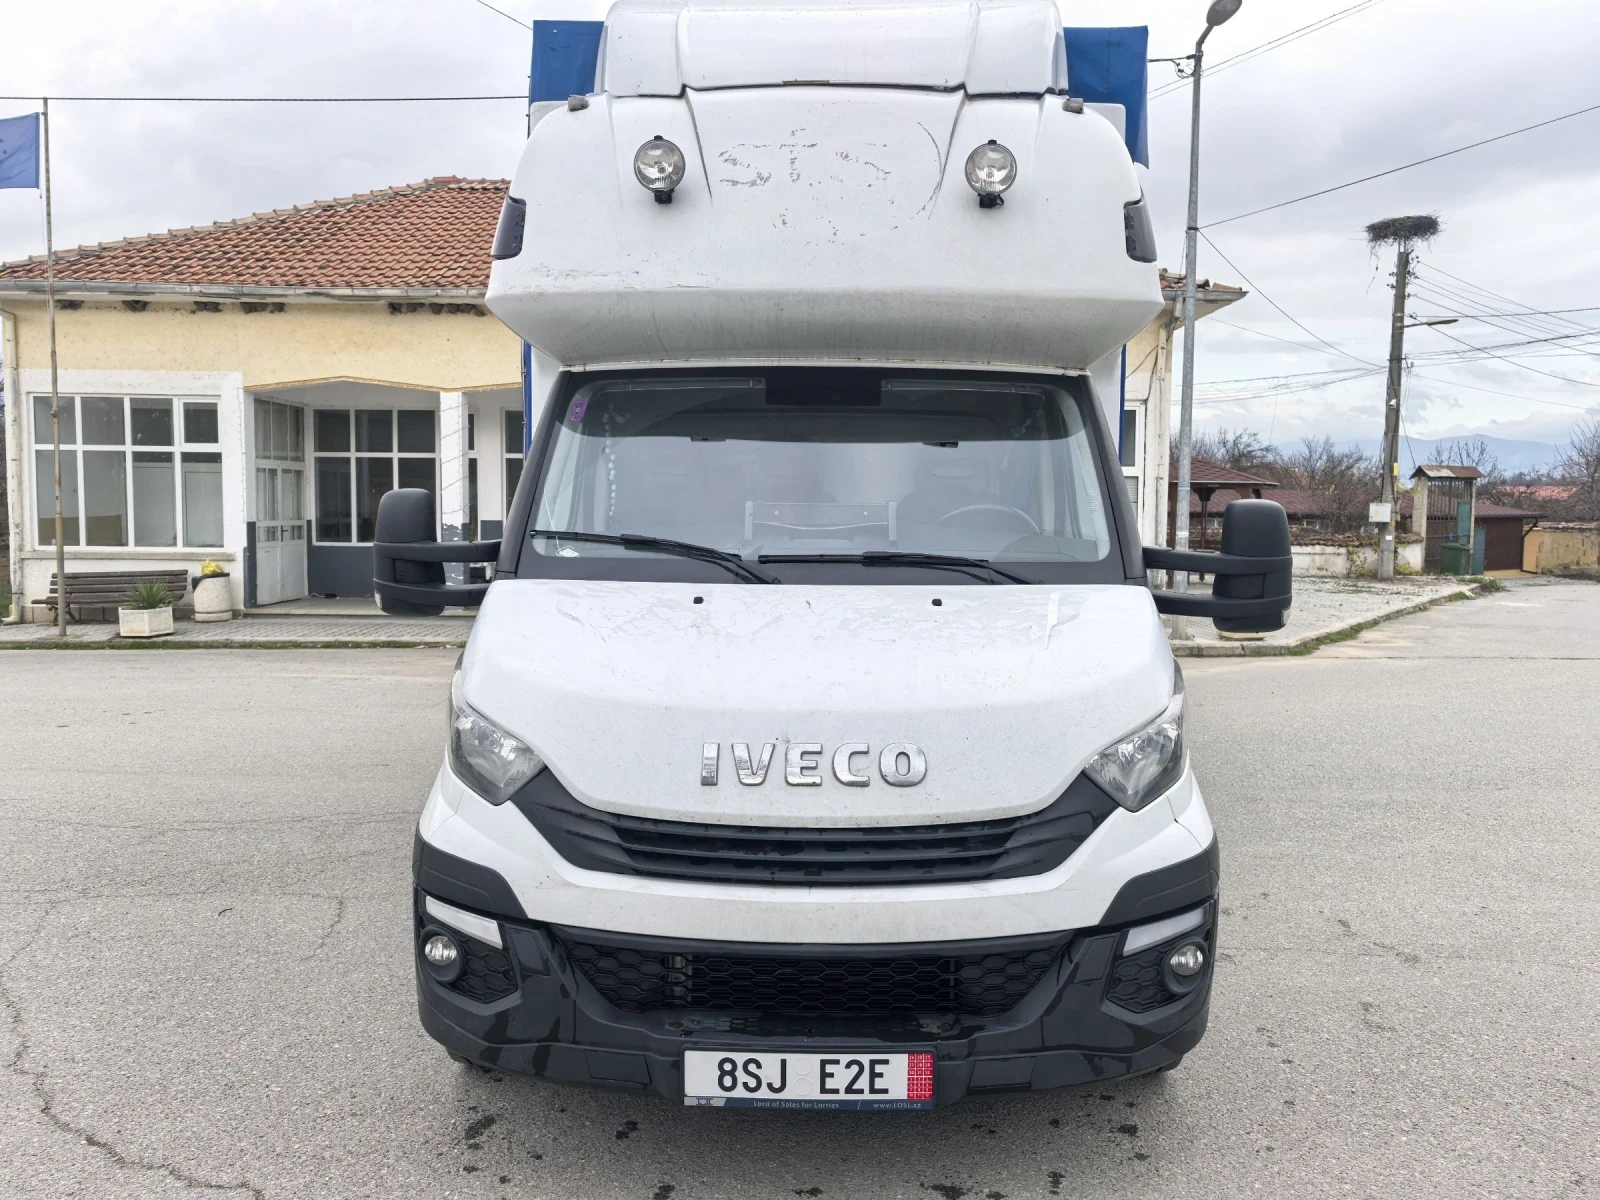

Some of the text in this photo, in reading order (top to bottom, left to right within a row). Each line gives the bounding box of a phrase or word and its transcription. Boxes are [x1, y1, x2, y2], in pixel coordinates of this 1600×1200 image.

[700, 742, 927, 787] IVECO
[717, 1056, 890, 1095] 8SJ E2E
[814, 1101, 839, 1109] Lorries
